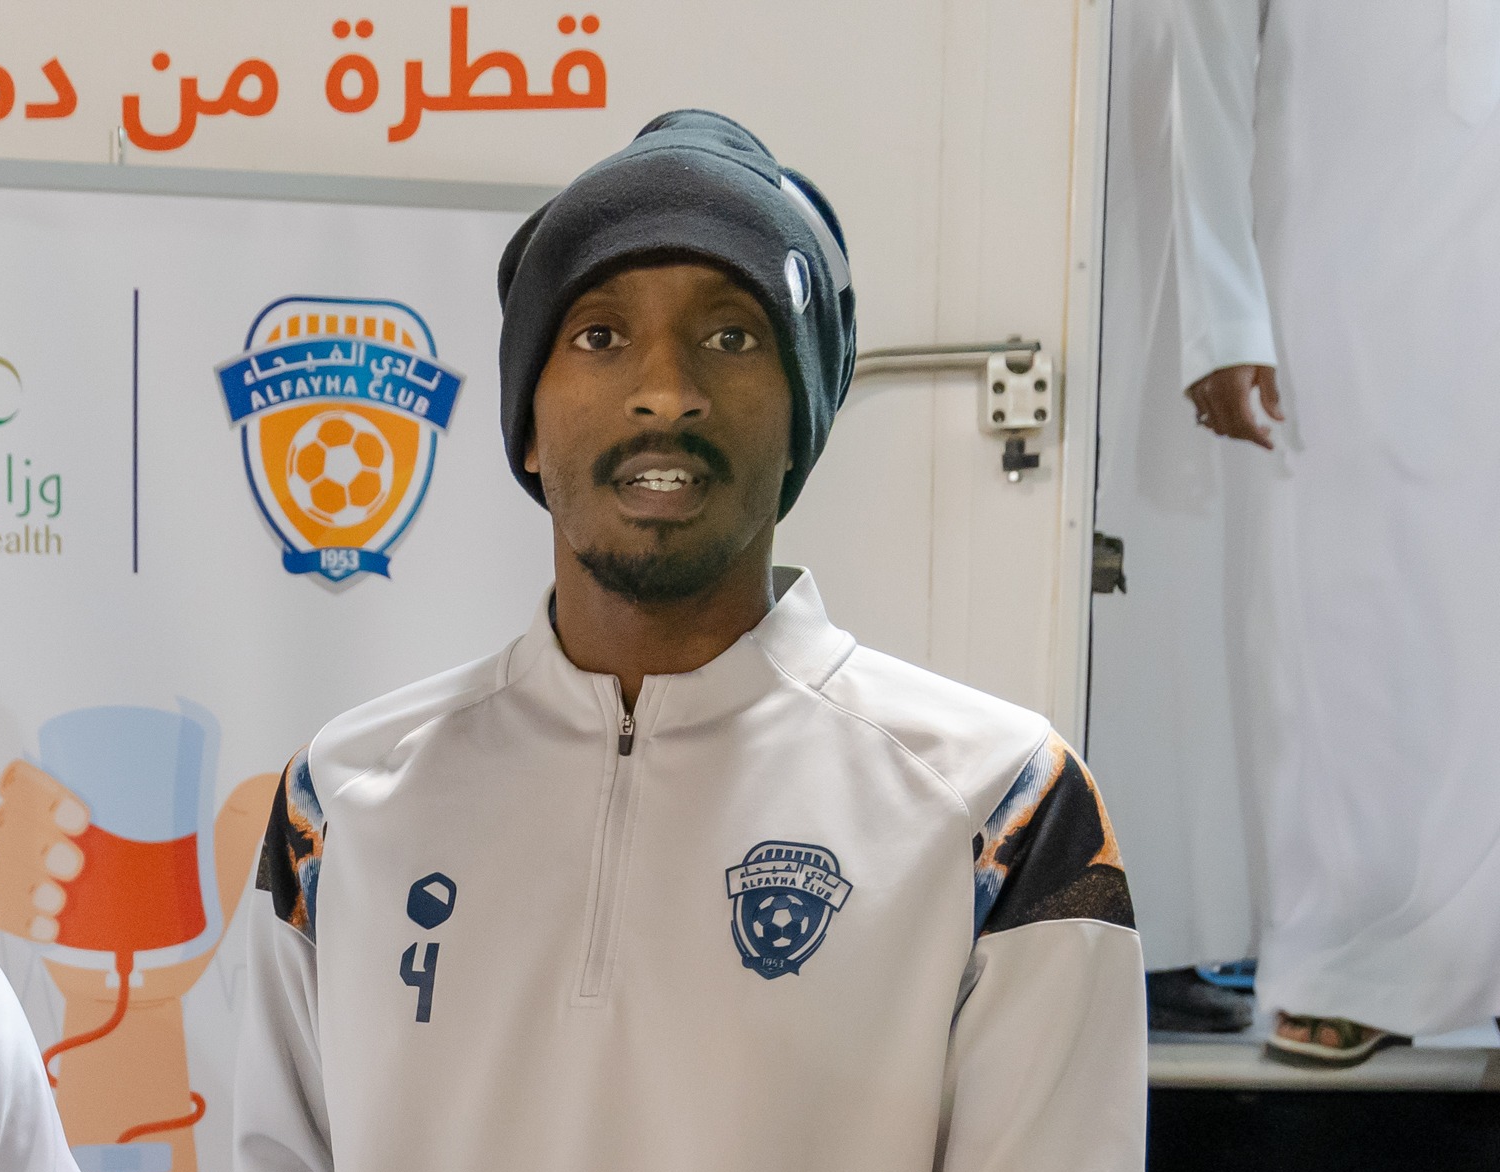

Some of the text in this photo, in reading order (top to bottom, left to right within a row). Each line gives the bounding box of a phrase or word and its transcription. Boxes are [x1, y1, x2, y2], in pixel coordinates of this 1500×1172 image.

[325, 5, 607, 143] قطرة
[121, 51, 279, 151] من
[244, 342, 441, 391] نادي الفيحاء
[250, 375, 430, 416] ALFAYHA CLUB
[320, 549, 360, 570] 1953
[741, 876, 832, 900] ALFAYHA CLUB
[399, 942, 440, 1023] 4
[762, 957, 785, 968] 1953
